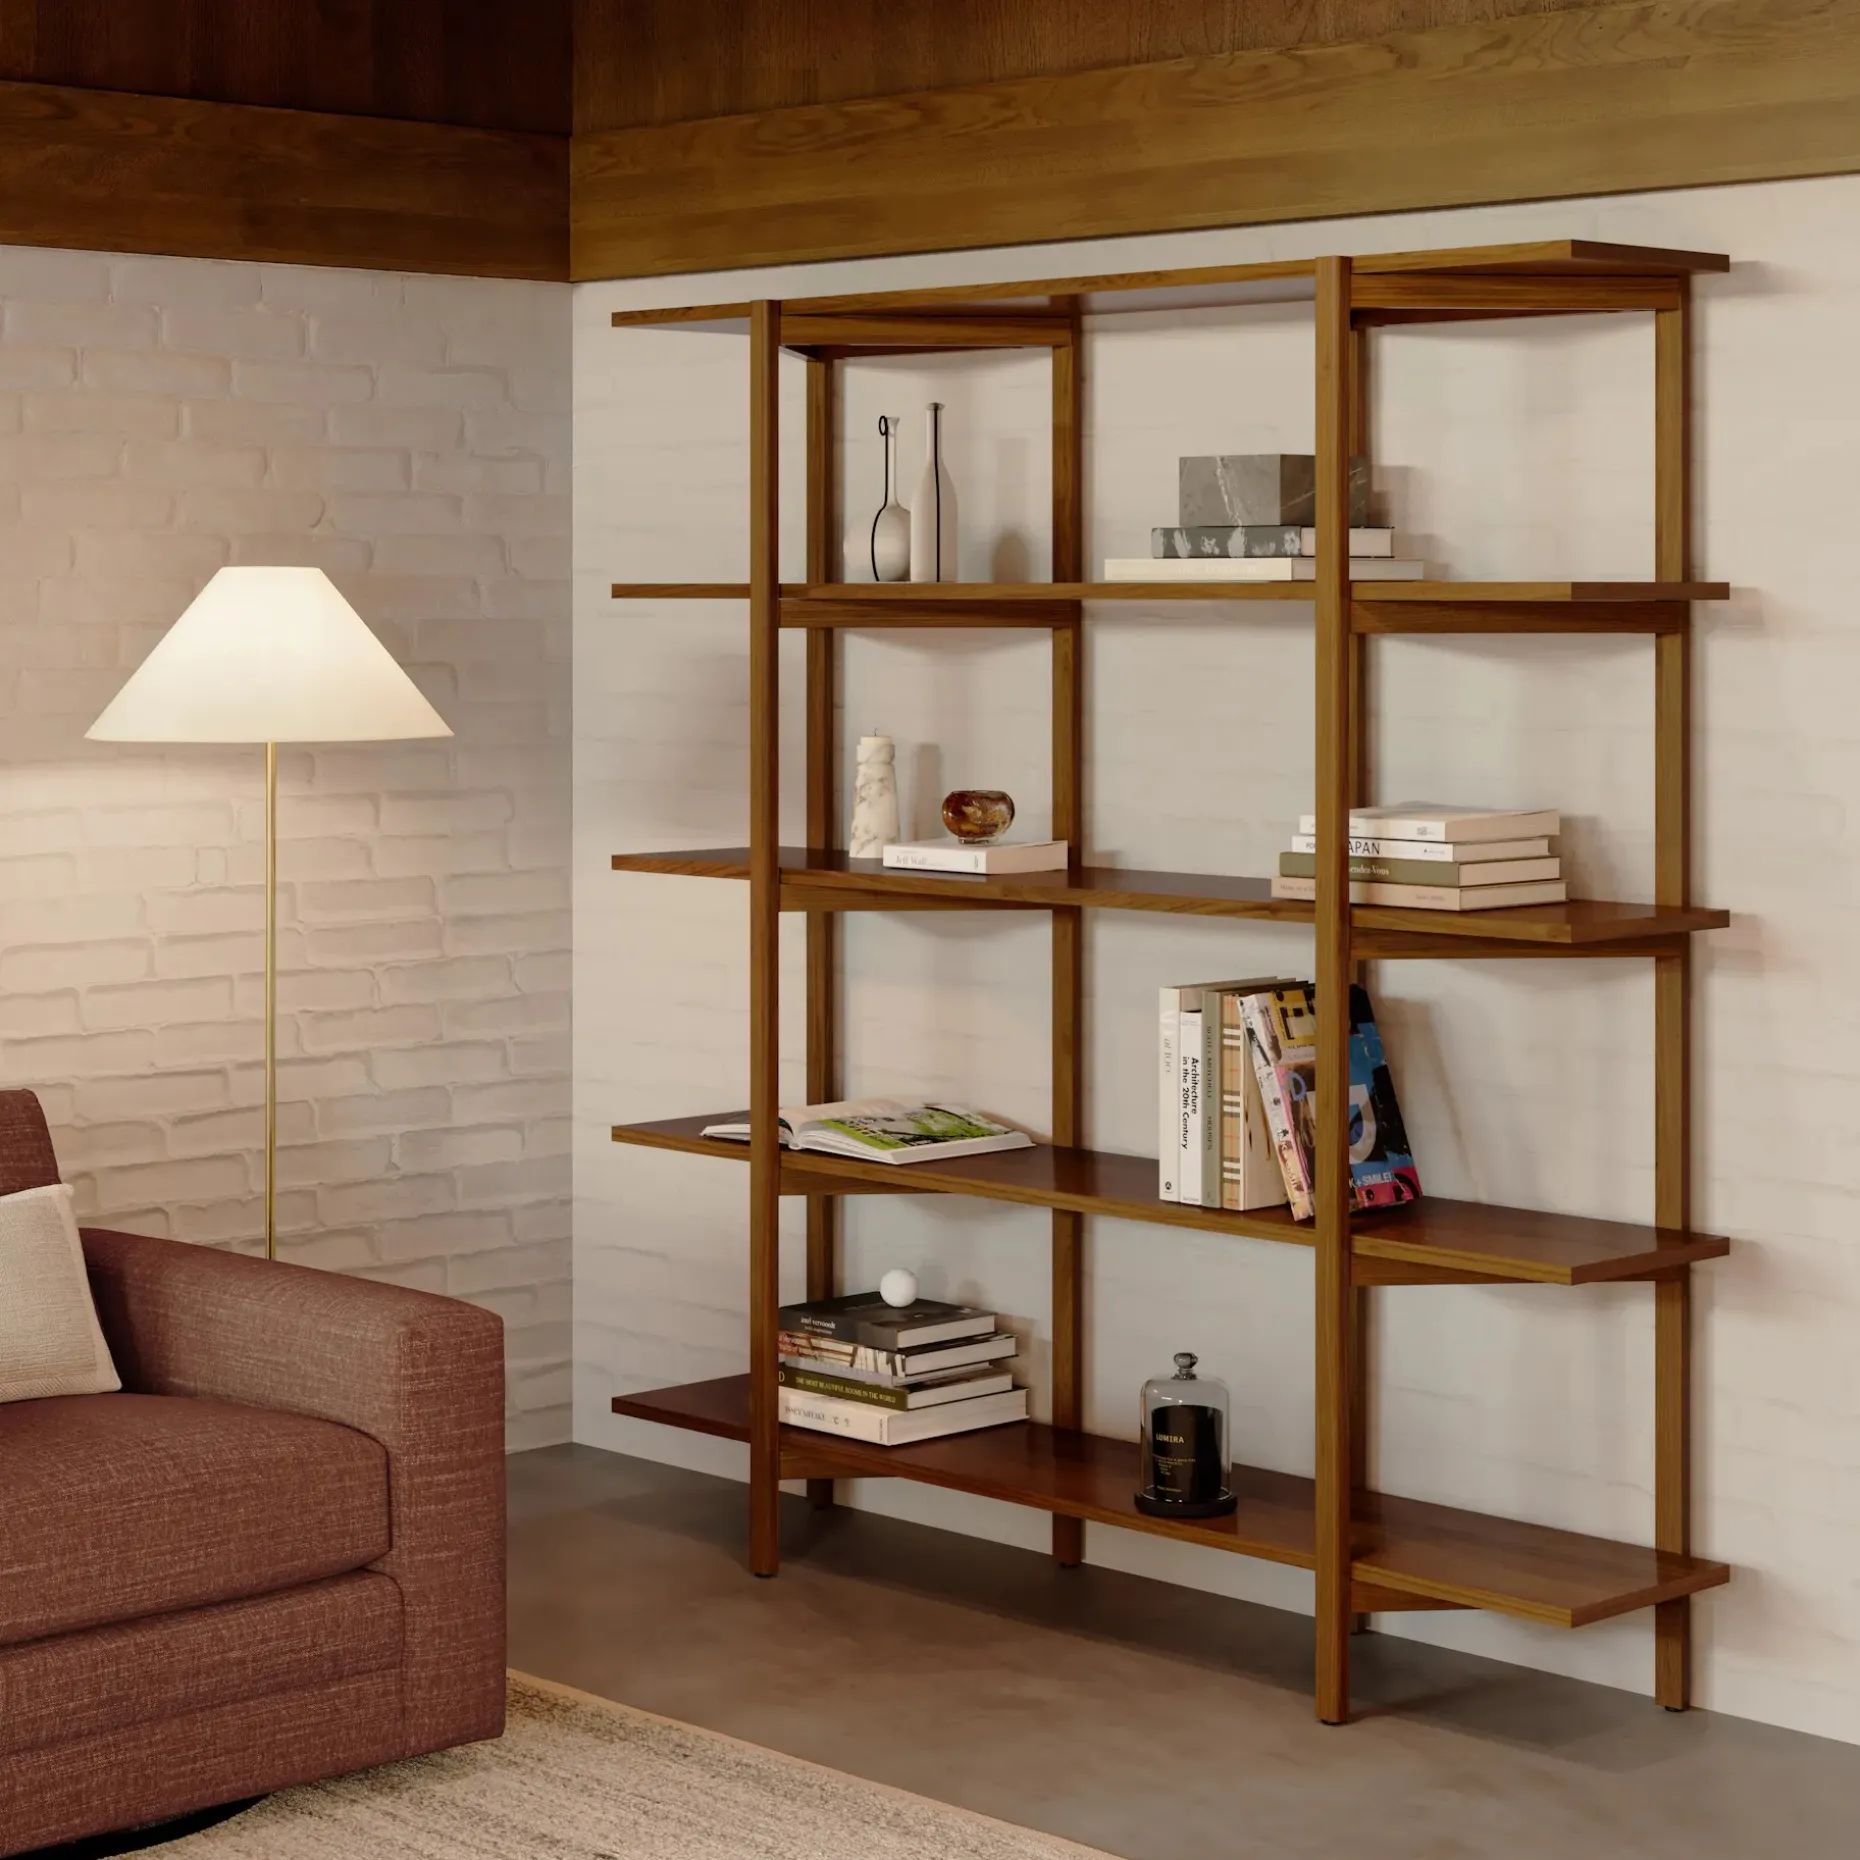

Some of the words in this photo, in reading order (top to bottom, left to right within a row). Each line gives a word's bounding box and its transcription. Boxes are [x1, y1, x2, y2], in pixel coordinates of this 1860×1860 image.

[1348, 840, 1381, 856] APAN
[1348, 864, 1390, 876] endez-Vous
[1182, 1056, 1190, 1065] in
[1182, 1067, 1190, 1083] the
[1191, 1057, 1200, 1115] Architecture
[1182, 1088, 1190, 1109] 20th
[1181, 1112, 1190, 1150] Century
[869, 1391, 878, 1400] THE
[1155, 1433, 1185, 1443] LUMIRA
